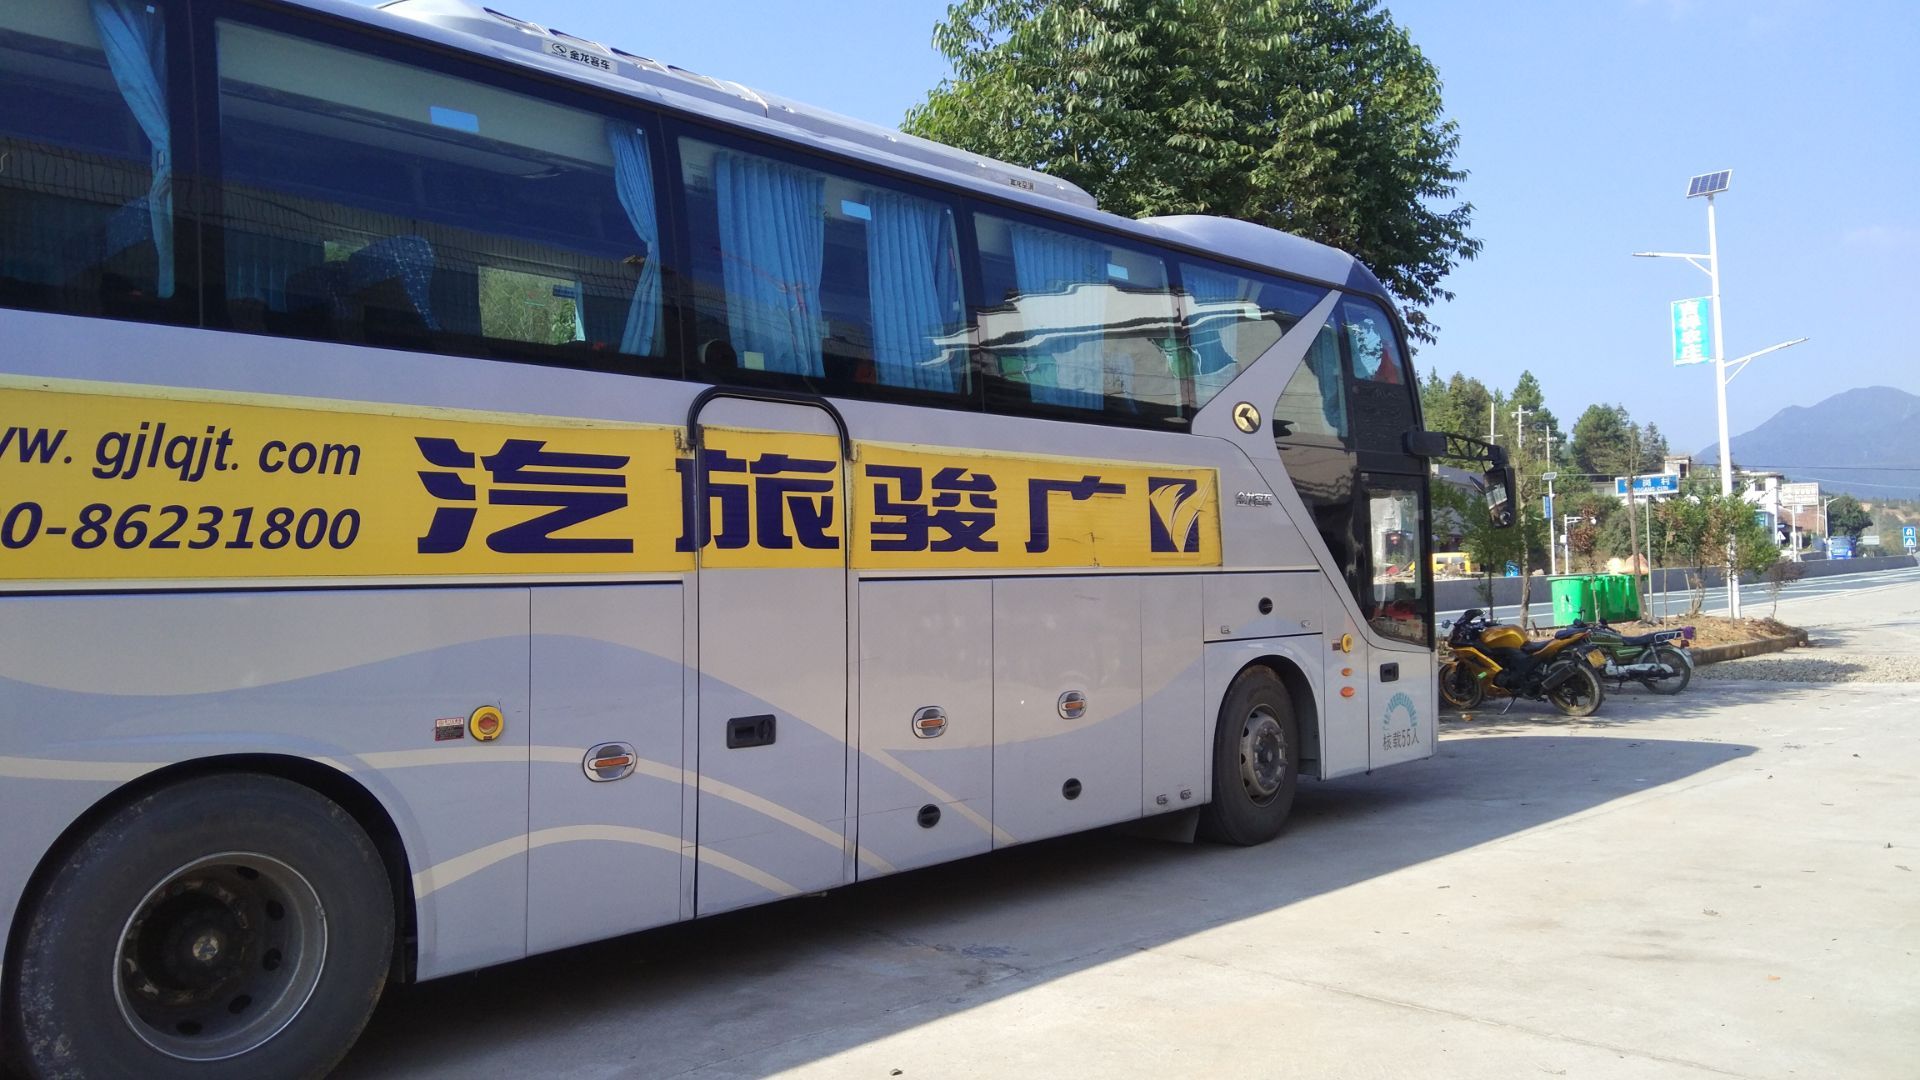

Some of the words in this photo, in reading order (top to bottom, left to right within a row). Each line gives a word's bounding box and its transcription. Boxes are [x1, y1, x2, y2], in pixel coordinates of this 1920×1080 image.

[569, 50, 610, 69] 金龙客车
[259, 440, 361, 475] com
[0, 502, 361, 550] 0-86231800
